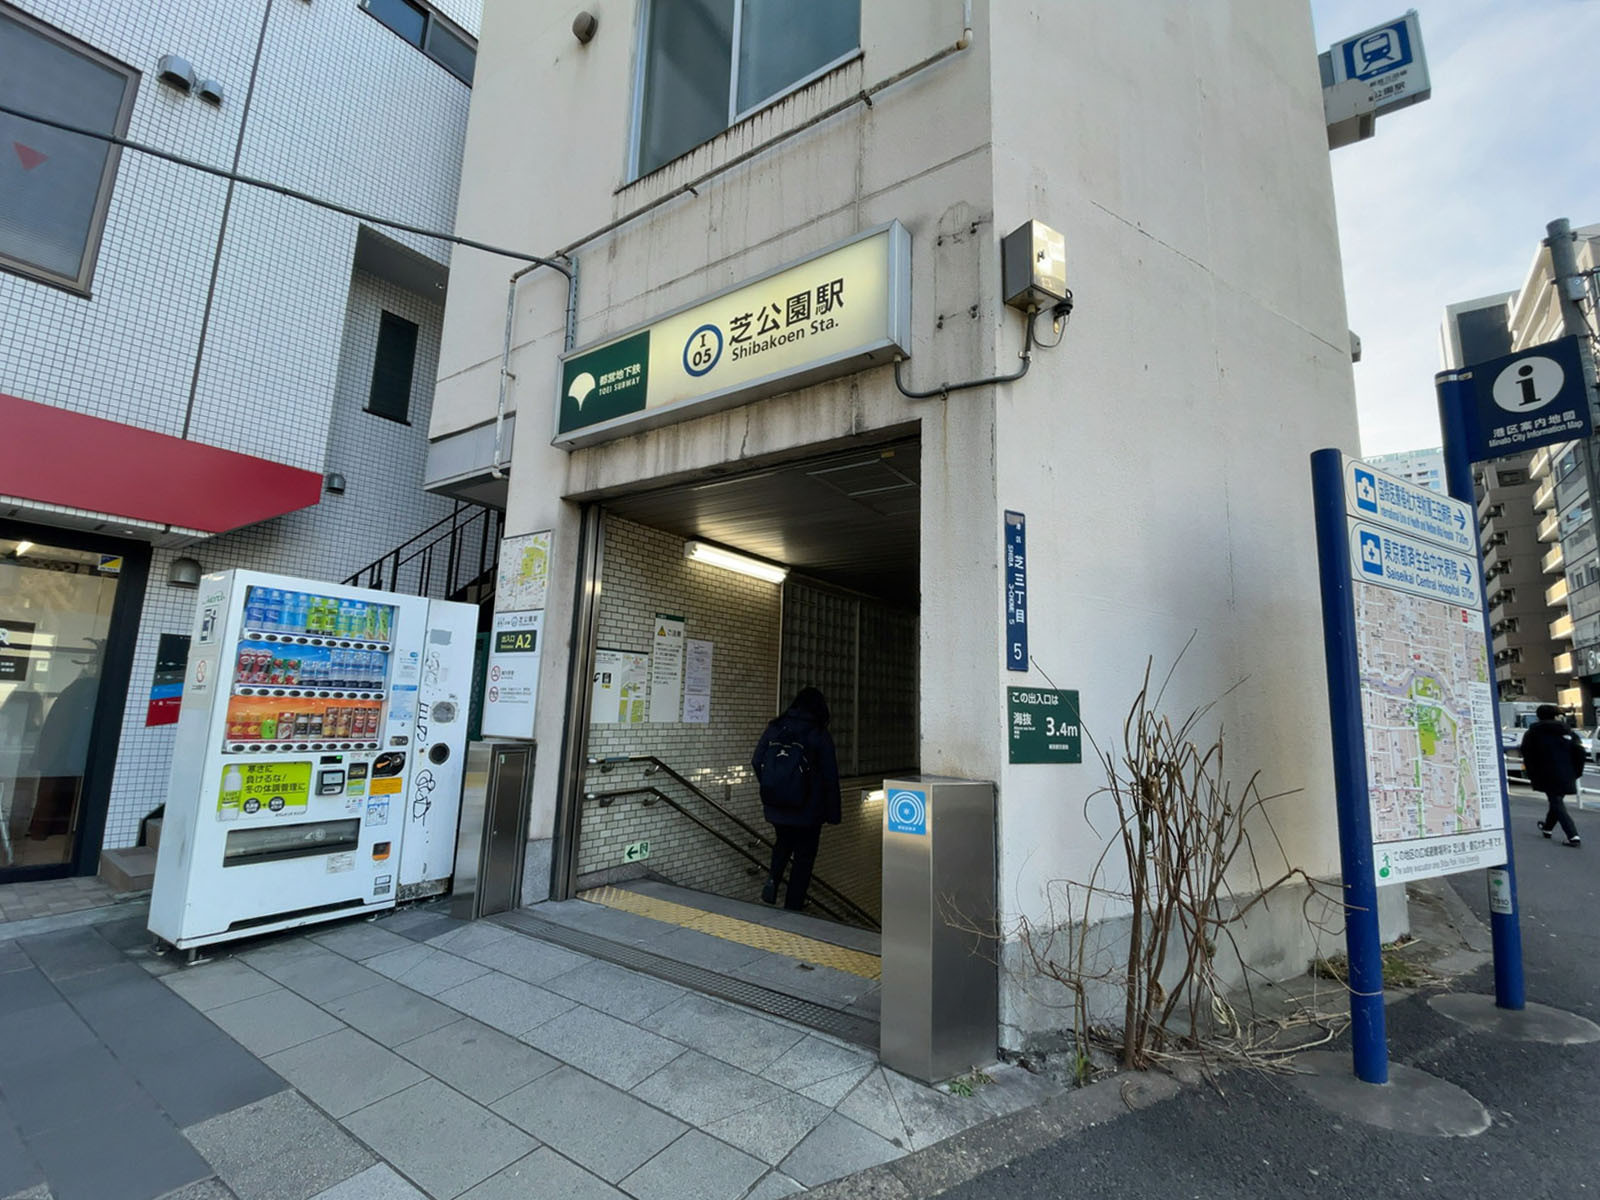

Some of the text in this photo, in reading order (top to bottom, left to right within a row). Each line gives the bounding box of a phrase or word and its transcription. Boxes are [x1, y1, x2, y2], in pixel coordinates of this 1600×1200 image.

[729, 277, 844, 347] 芝公園駅
[699, 333, 707, 348] I
[732, 318, 840, 362] Shibakoen Sta.
[692, 350, 712, 367] 05
[599, 363, 641, 386] 都営地下鉄
[614, 376, 641, 391] SUBWAY
[515, 633, 532, 649] A2
[1013, 643, 1022, 660] 5
[1012, 692, 1059, 705] この出入口は
[1013, 712, 1032, 725] 海抜
[1046, 716, 1078, 737] 3.4m
